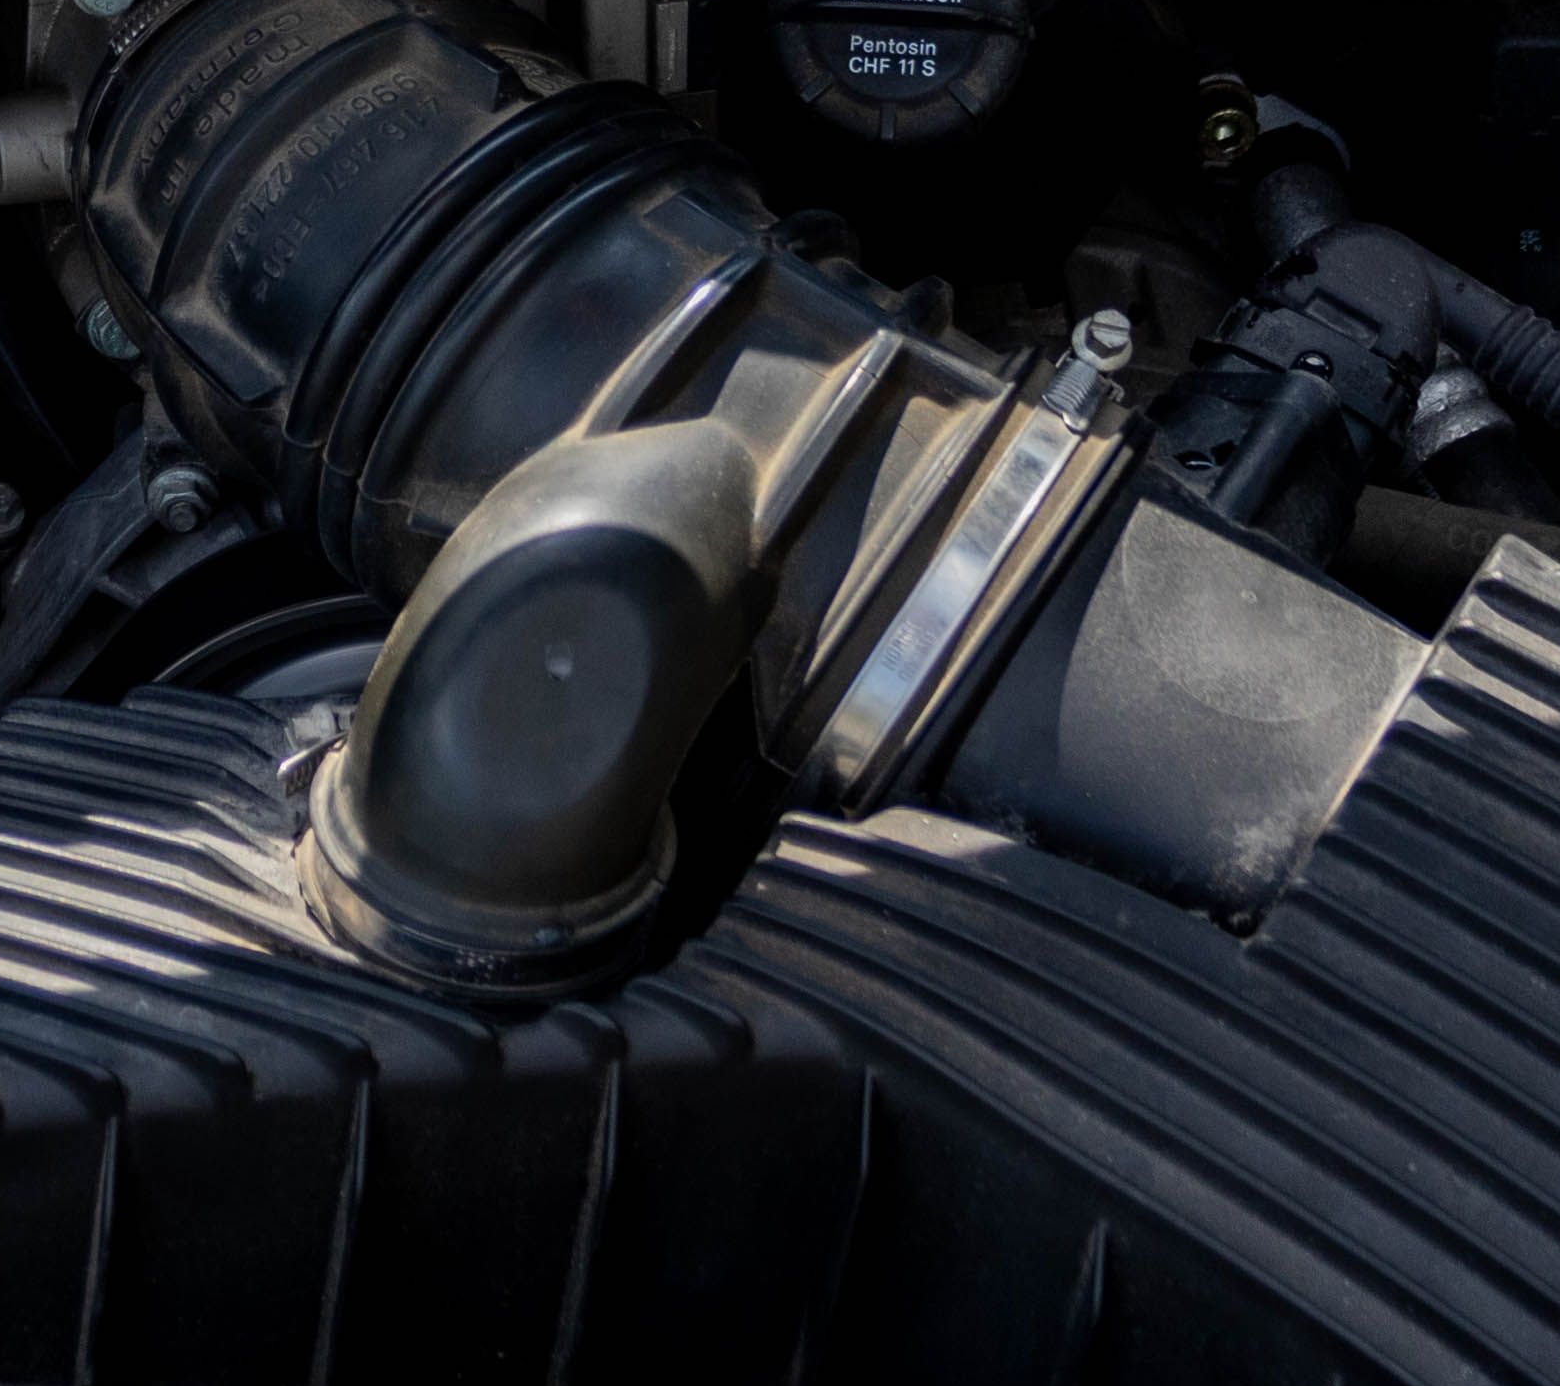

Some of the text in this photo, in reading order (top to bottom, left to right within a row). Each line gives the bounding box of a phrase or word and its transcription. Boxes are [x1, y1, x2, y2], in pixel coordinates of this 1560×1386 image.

[849, 34, 938, 57] Pentosin
[847, 56, 937, 78] CHF 11 S
